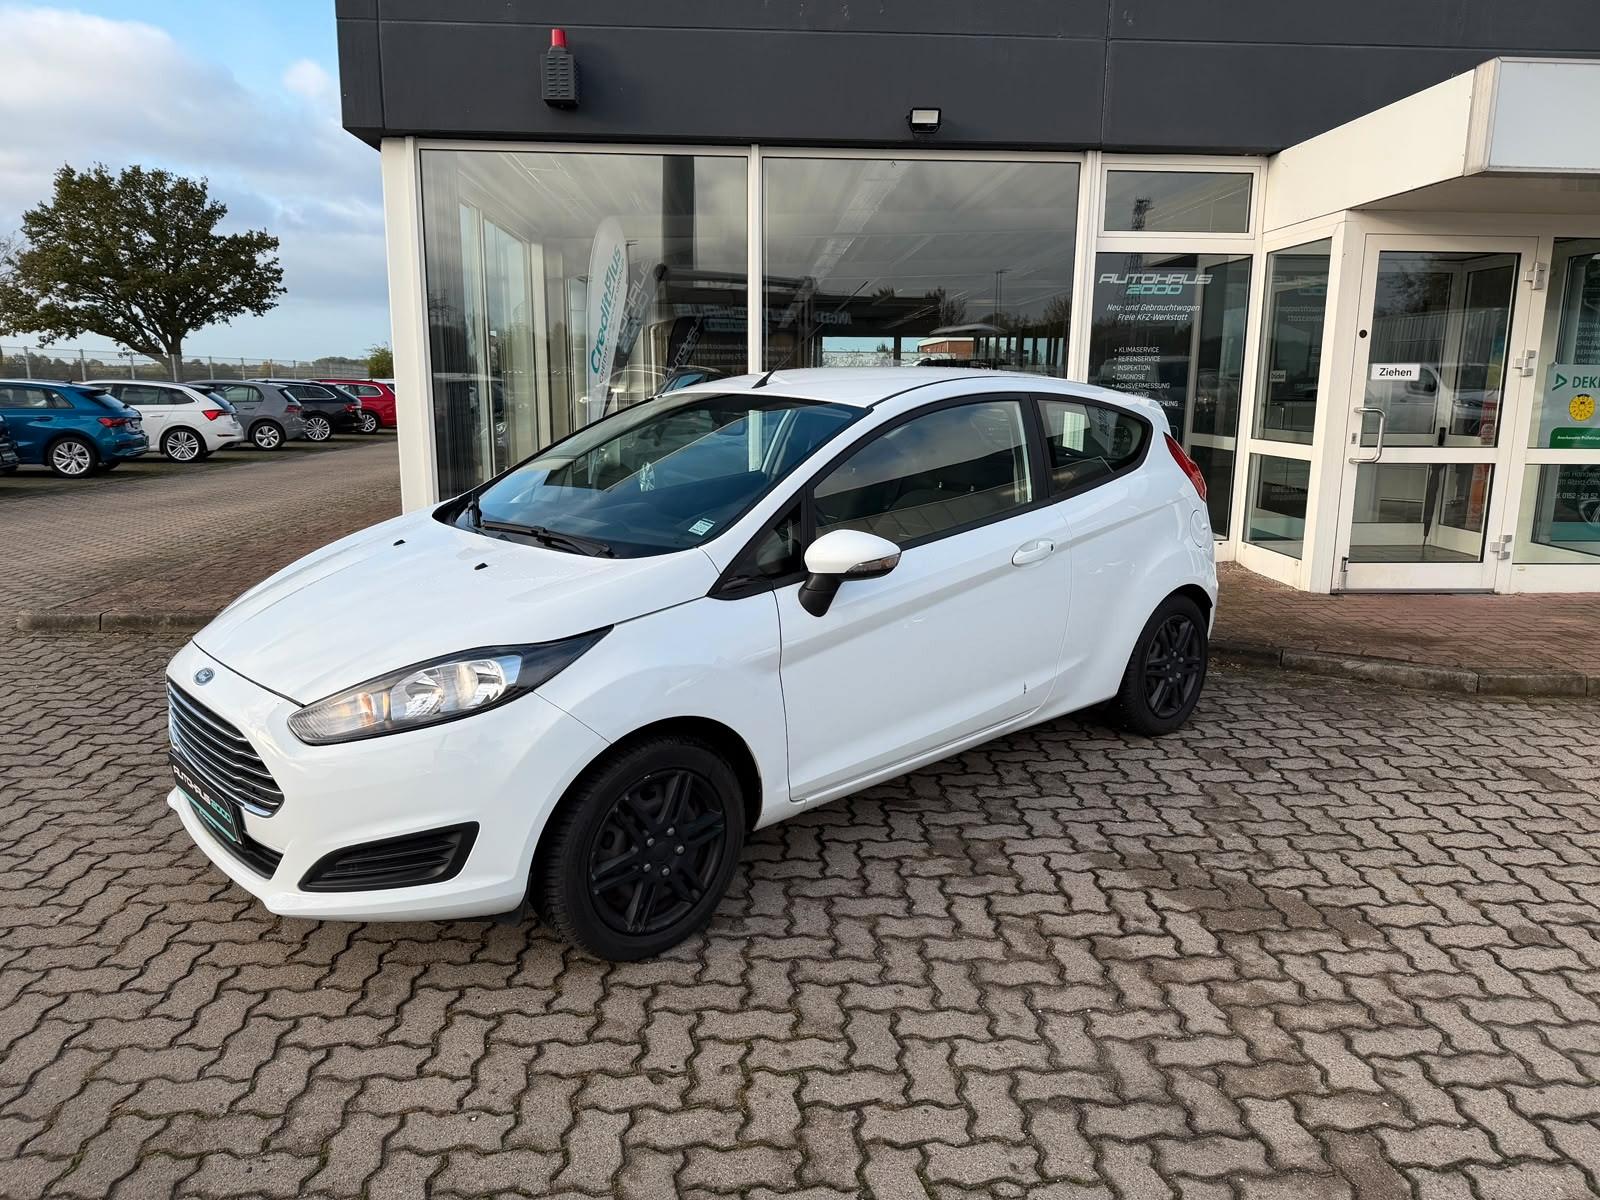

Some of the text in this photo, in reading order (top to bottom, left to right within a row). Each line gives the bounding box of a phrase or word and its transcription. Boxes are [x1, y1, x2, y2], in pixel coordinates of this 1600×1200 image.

[1099, 273, 1213, 285] AUTOHAUS
[1126, 284, 1183, 295] 2000
[591, 245, 621, 374] CreditPlus
[1140, 304, 1200, 313] Gebrauchtwagen
[1379, 367, 1412, 377] Ziehen
[173, 765, 211, 805] AUTOHAUS
[209, 799, 232, 824] 2000
